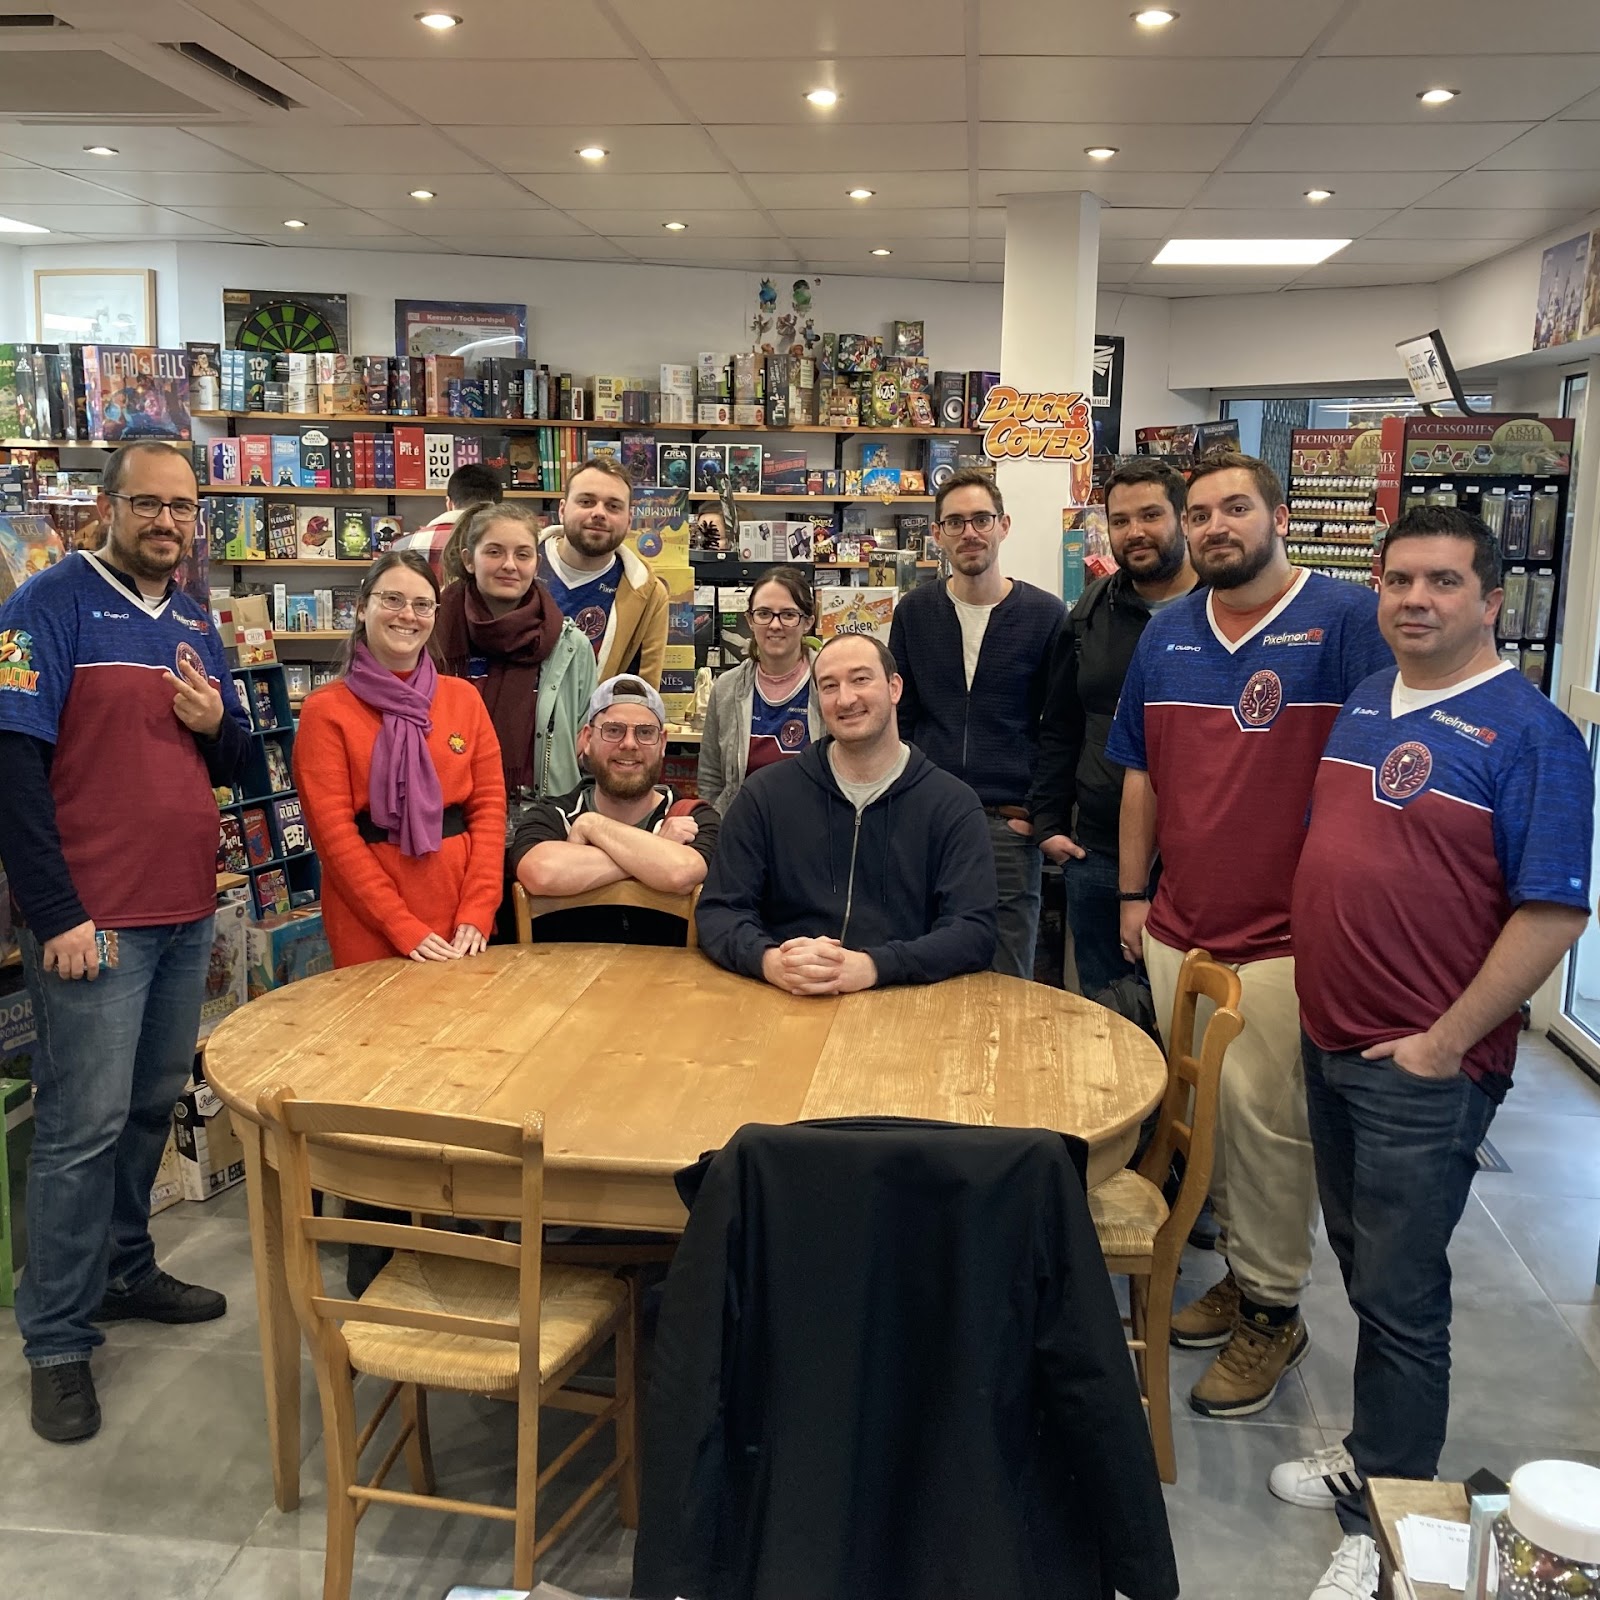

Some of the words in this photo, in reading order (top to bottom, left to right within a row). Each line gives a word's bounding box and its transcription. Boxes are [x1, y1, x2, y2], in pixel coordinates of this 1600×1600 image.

[102, 352, 139, 378] DEAD
[151, 353, 187, 379] CELLS
[249, 357, 269, 370] TOP
[250, 371, 266, 381] TEN
[943, 380, 963, 389] HITSTE
[1091, 397, 1110, 406] MMER
[1409, 423, 1495, 435] ACCESSORIES
[1507, 426, 1546, 435] ARMY
[664, 450, 688, 458] CREW
[699, 450, 722, 458] CREW
[1379, 463, 1396, 472] TER
[631, 506, 681, 517] HARMONI
[270, 513, 294, 525] FLOWERS
[12, 522, 41, 537] DUEL
[1430, 709, 1498, 744] PixelmonFR
[0, 998, 34, 1028] DOR
